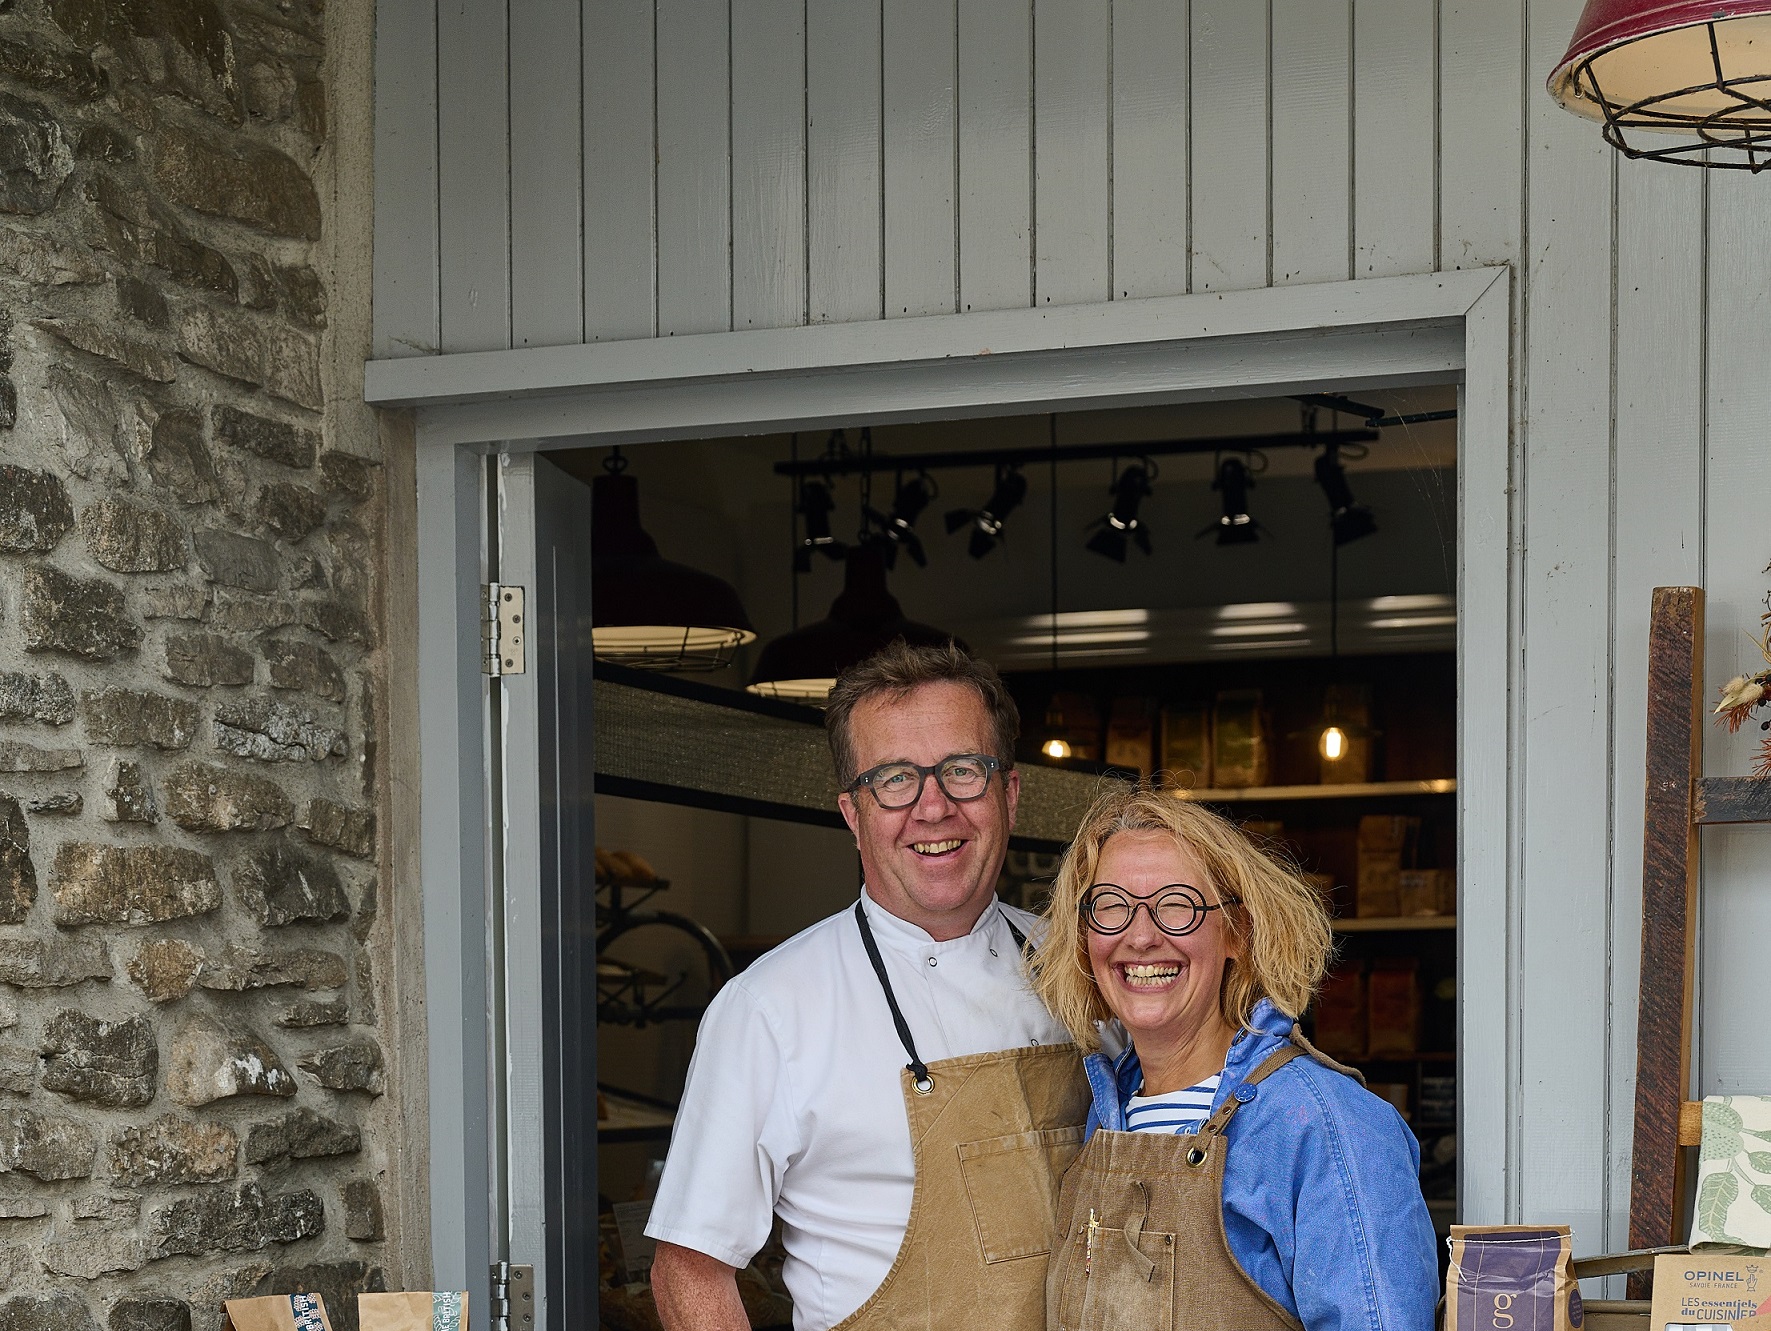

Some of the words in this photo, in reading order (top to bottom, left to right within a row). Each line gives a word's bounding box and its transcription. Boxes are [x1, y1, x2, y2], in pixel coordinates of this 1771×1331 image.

[1684, 1271, 1744, 1282] OPINEL
[1682, 1298, 1700, 1307] LES
[1701, 1299, 1757, 1309] essentiels
[300, 1295, 314, 1330] BRITISH
[1492, 1293, 1517, 1328] g
[1681, 1307, 1695, 1316] du
